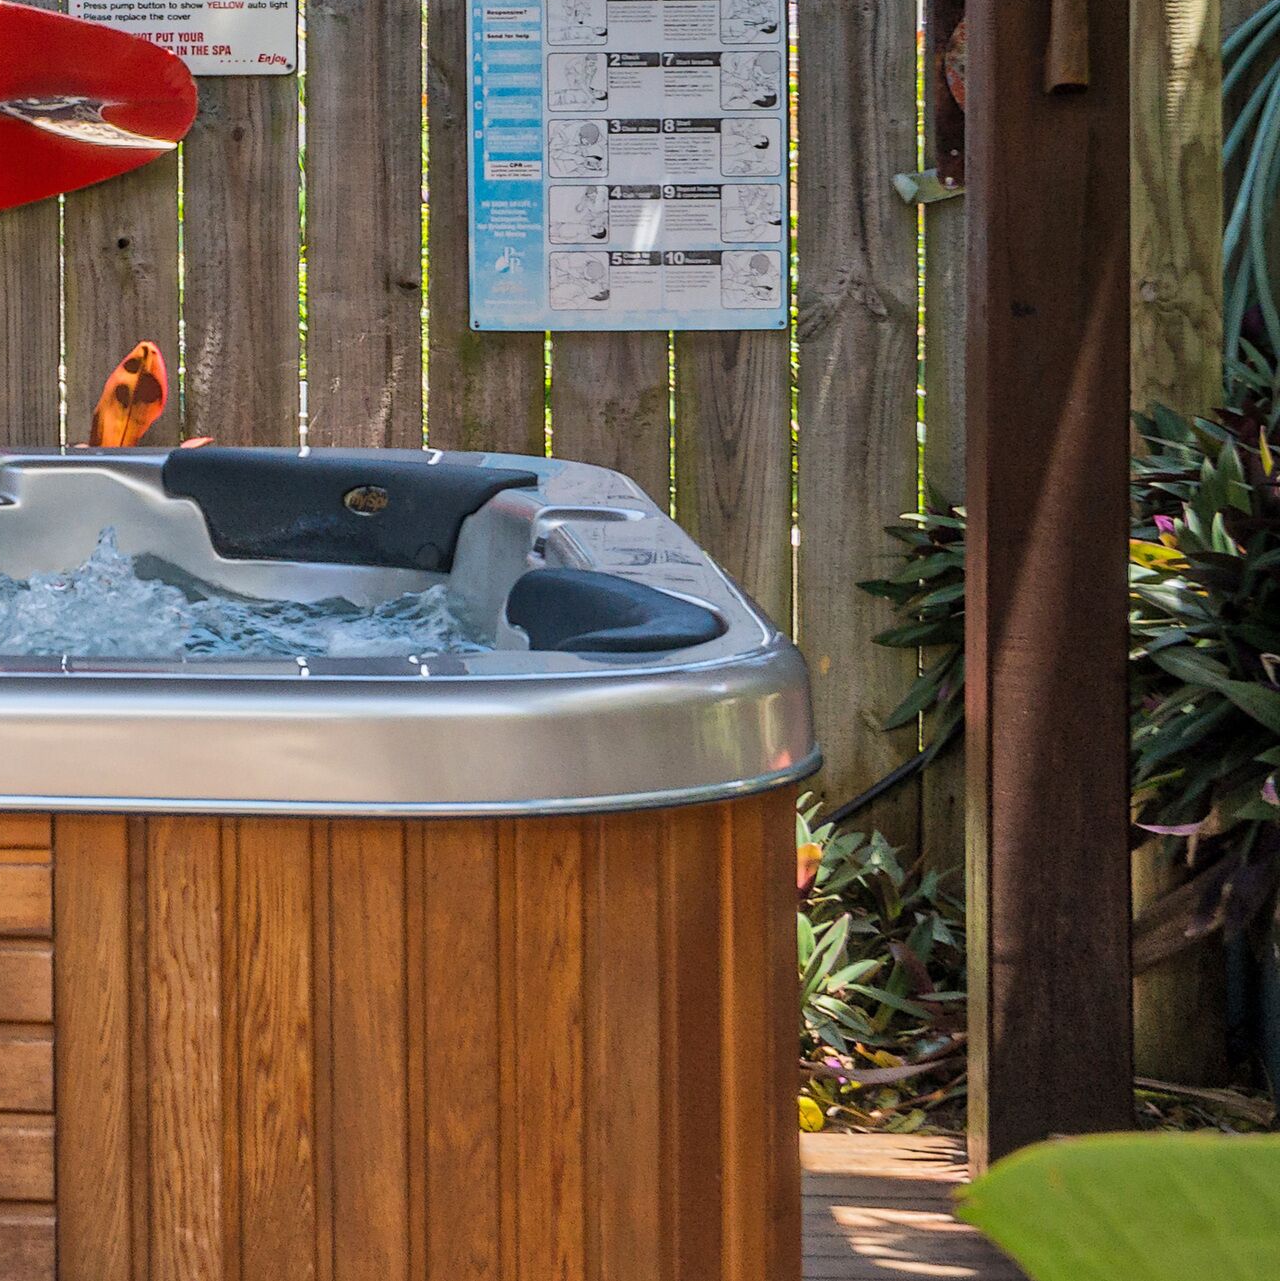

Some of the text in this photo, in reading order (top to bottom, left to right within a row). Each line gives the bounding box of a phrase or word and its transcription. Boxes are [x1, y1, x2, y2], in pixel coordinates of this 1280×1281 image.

[207, 1, 244, 9] YELLOW
[270, 1, 288, 10] light
[156, 32, 174, 42] PUT
[178, 32, 204, 42] YOUR
[177, 46, 187, 56] IN
[191, 45, 208, 56] THE
[212, 45, 231, 56] SPA
[258, 54, 288, 66] Enjoy
[610, 54, 621, 66] 2
[663, 53, 675, 66] 7
[610, 119, 621, 133] 3
[664, 119, 675, 132] 8
[611, 186, 622, 199] 4
[664, 186, 675, 198] 9
[612, 253, 622, 265] 5
[665, 252, 685, 265] 10
